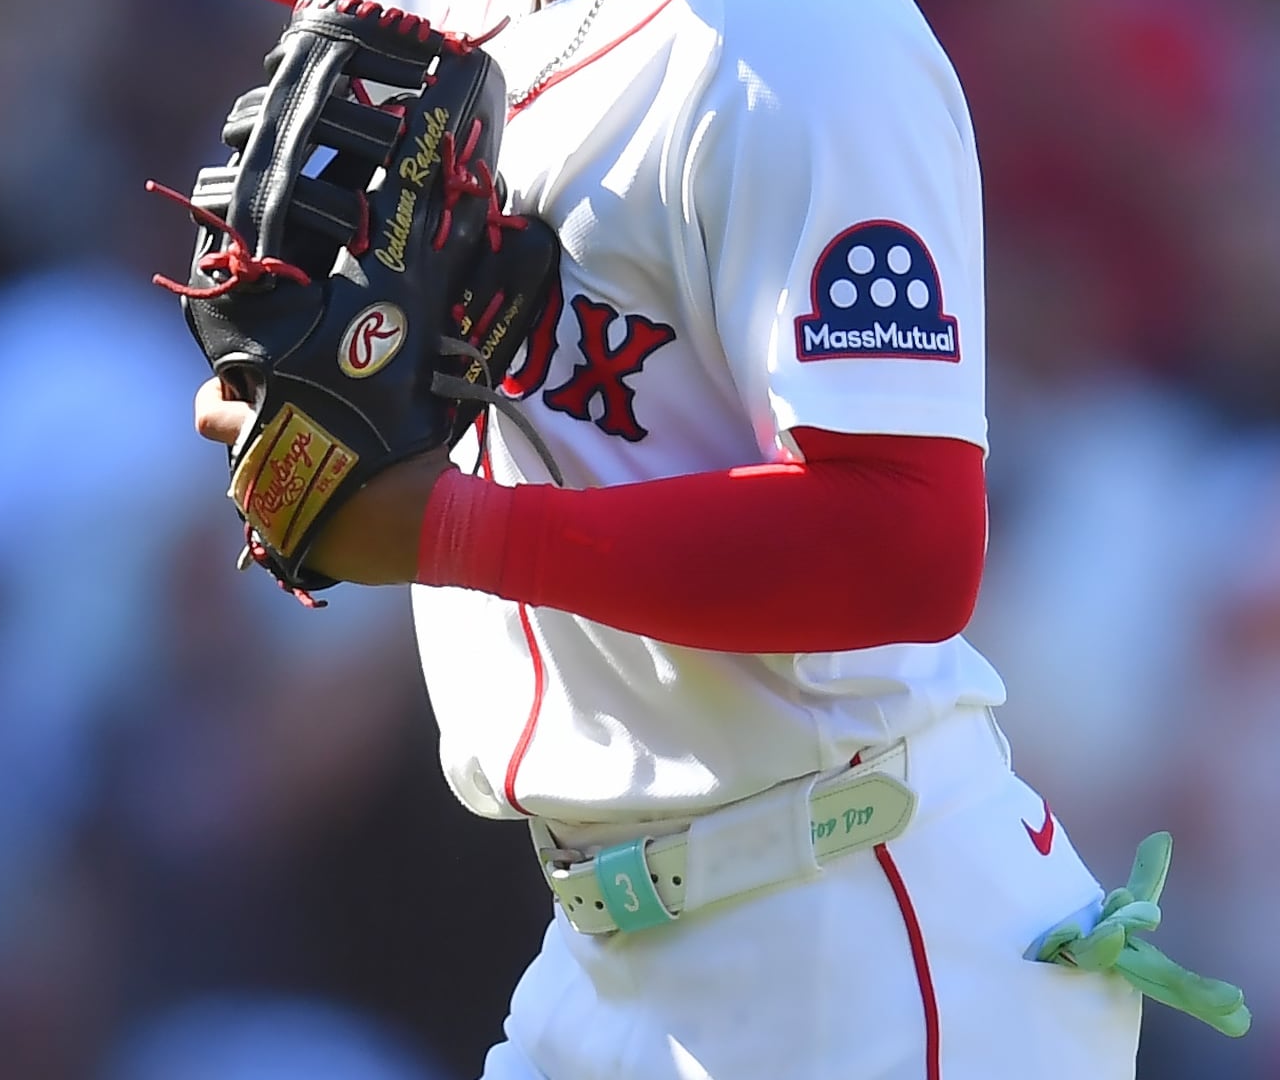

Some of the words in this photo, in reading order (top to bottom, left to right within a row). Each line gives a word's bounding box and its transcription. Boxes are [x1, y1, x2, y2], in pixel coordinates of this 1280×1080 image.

[398, 106, 450, 188] Rafaela
[803, 321, 955, 352] MassMutual
[253, 432, 313, 529] Rawlings
[614, 873, 640, 913] 3
